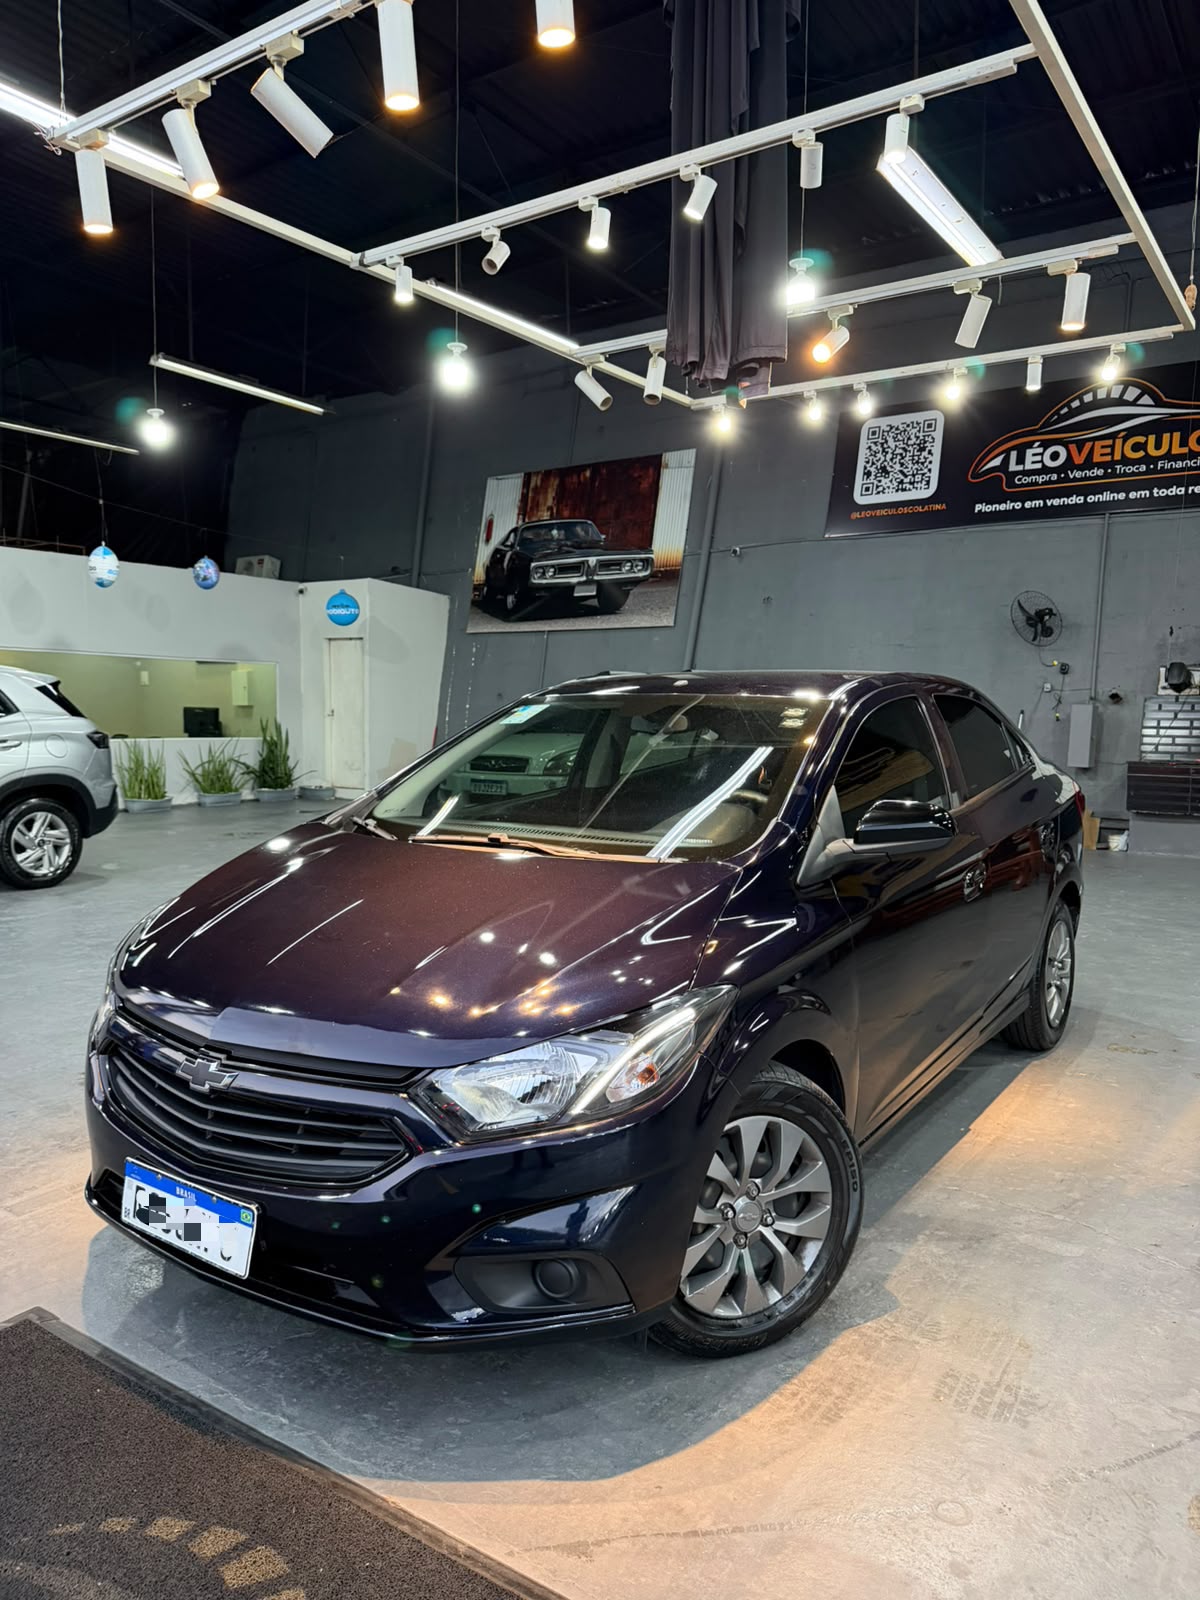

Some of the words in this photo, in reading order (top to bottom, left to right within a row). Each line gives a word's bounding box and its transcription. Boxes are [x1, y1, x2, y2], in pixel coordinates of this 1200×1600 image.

[1015, 473, 1057, 485] Compra
[1068, 467, 1104, 479] Vende
[1115, 464, 1146, 475] Troca
[974, 501, 1022, 513] Pioneiro
[1024, 500, 1043, 510] em
[1046, 494, 1084, 507] venda
[1087, 491, 1126, 503] online
[1129, 489, 1150, 499] em
[1153, 485, 1186, 497] toda
[850, 503, 946, 520] @LEOVEICULOSCOLATINA
[175, 1186, 197, 1202] BRASIL
